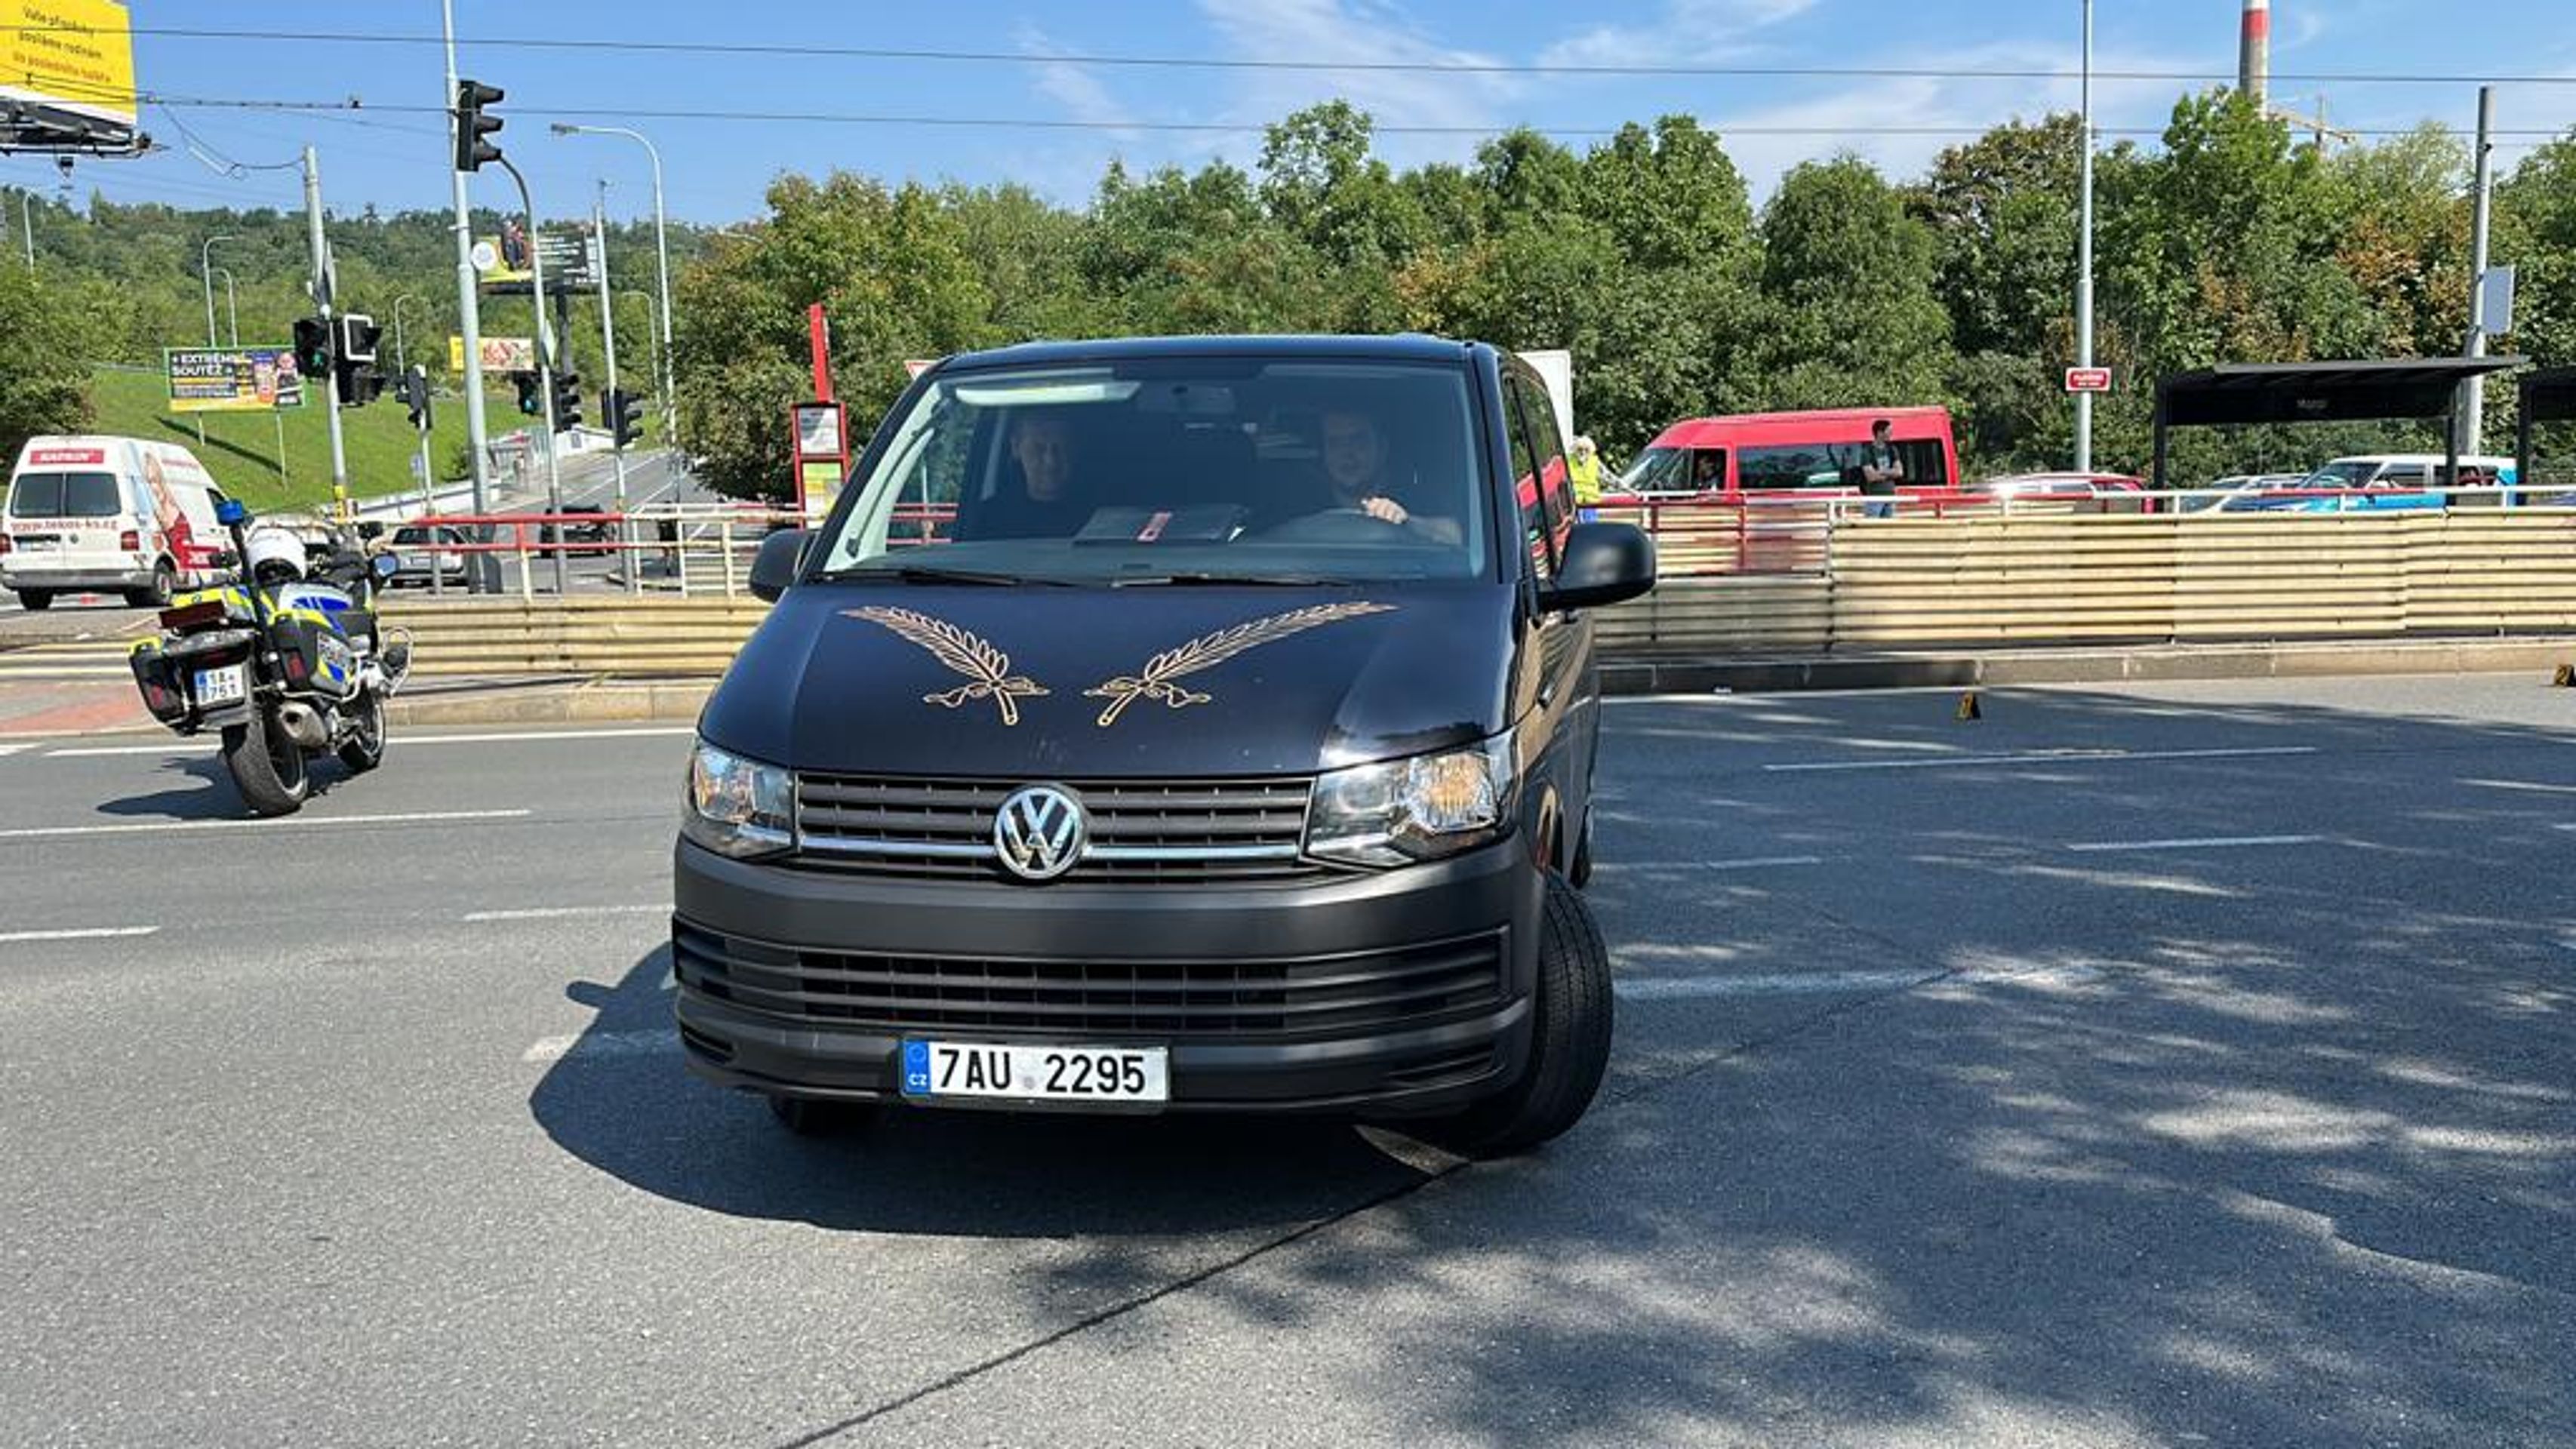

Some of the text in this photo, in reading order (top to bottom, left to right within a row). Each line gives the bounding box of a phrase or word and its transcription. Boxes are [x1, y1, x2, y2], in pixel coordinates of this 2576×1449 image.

[908, 1048, 1146, 1094] CZ 7AU 2295
